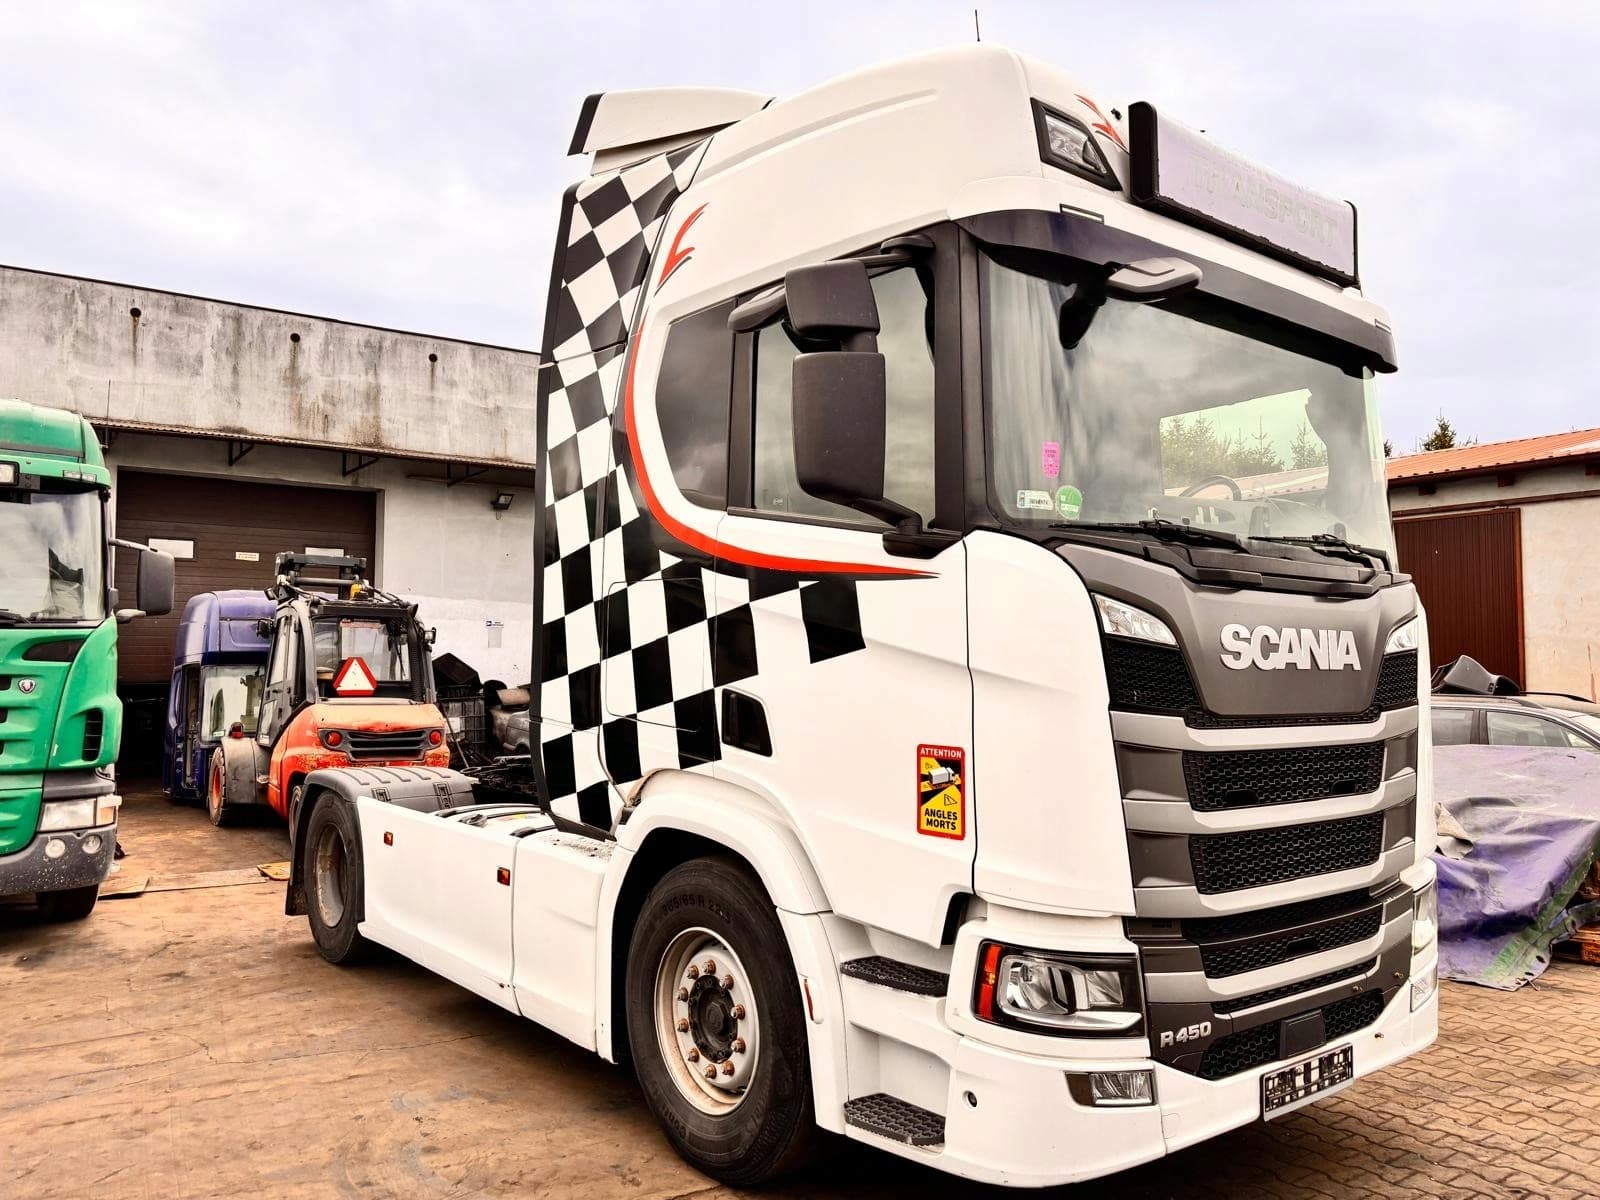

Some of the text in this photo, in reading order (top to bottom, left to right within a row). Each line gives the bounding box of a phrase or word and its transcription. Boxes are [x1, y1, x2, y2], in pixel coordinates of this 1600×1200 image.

[1220, 623, 1361, 671] SCANIA
[920, 748, 962, 758] ATTENTION
[924, 807, 958, 821] ANGLES
[926, 818, 957, 831] MORTS
[1160, 1021, 1212, 1049] R 450
